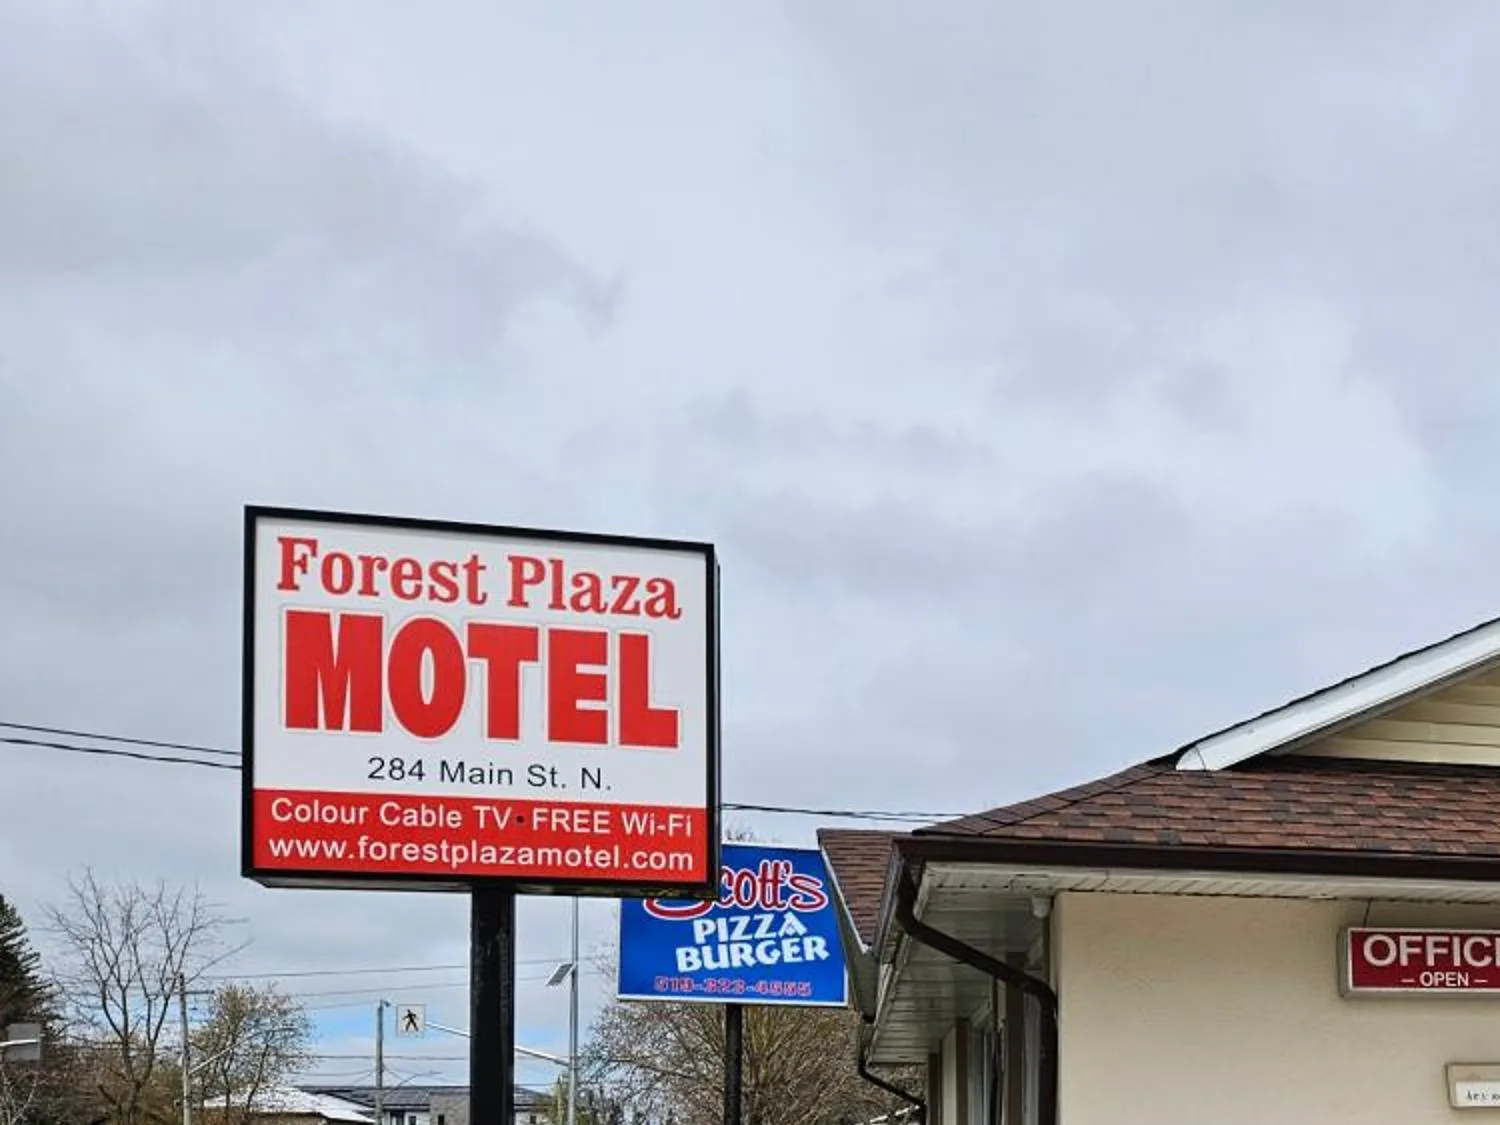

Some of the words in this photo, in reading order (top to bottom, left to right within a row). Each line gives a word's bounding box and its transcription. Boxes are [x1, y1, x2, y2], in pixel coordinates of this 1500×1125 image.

[277, 537, 487, 605] Forest
[507, 555, 682, 620] Plaza
[284, 608, 680, 749] MOTEL
[367, 757, 426, 782] 284
[440, 760, 514, 786] Main
[527, 765, 567, 789] St.
[580, 767, 612, 791] N.
[271, 797, 369, 824] Colour
[379, 800, 462, 829] Cable
[473, 805, 509, 829] TV
[533, 807, 610, 834] FREE
[621, 812, 693, 836] Wi-Fi
[269, 836, 693, 870] www.forestplazamotel.com
[693, 911, 808, 944] PIZZA
[676, 935, 830, 973] BURGER
[1420, 972, 1469, 986] OPEN
